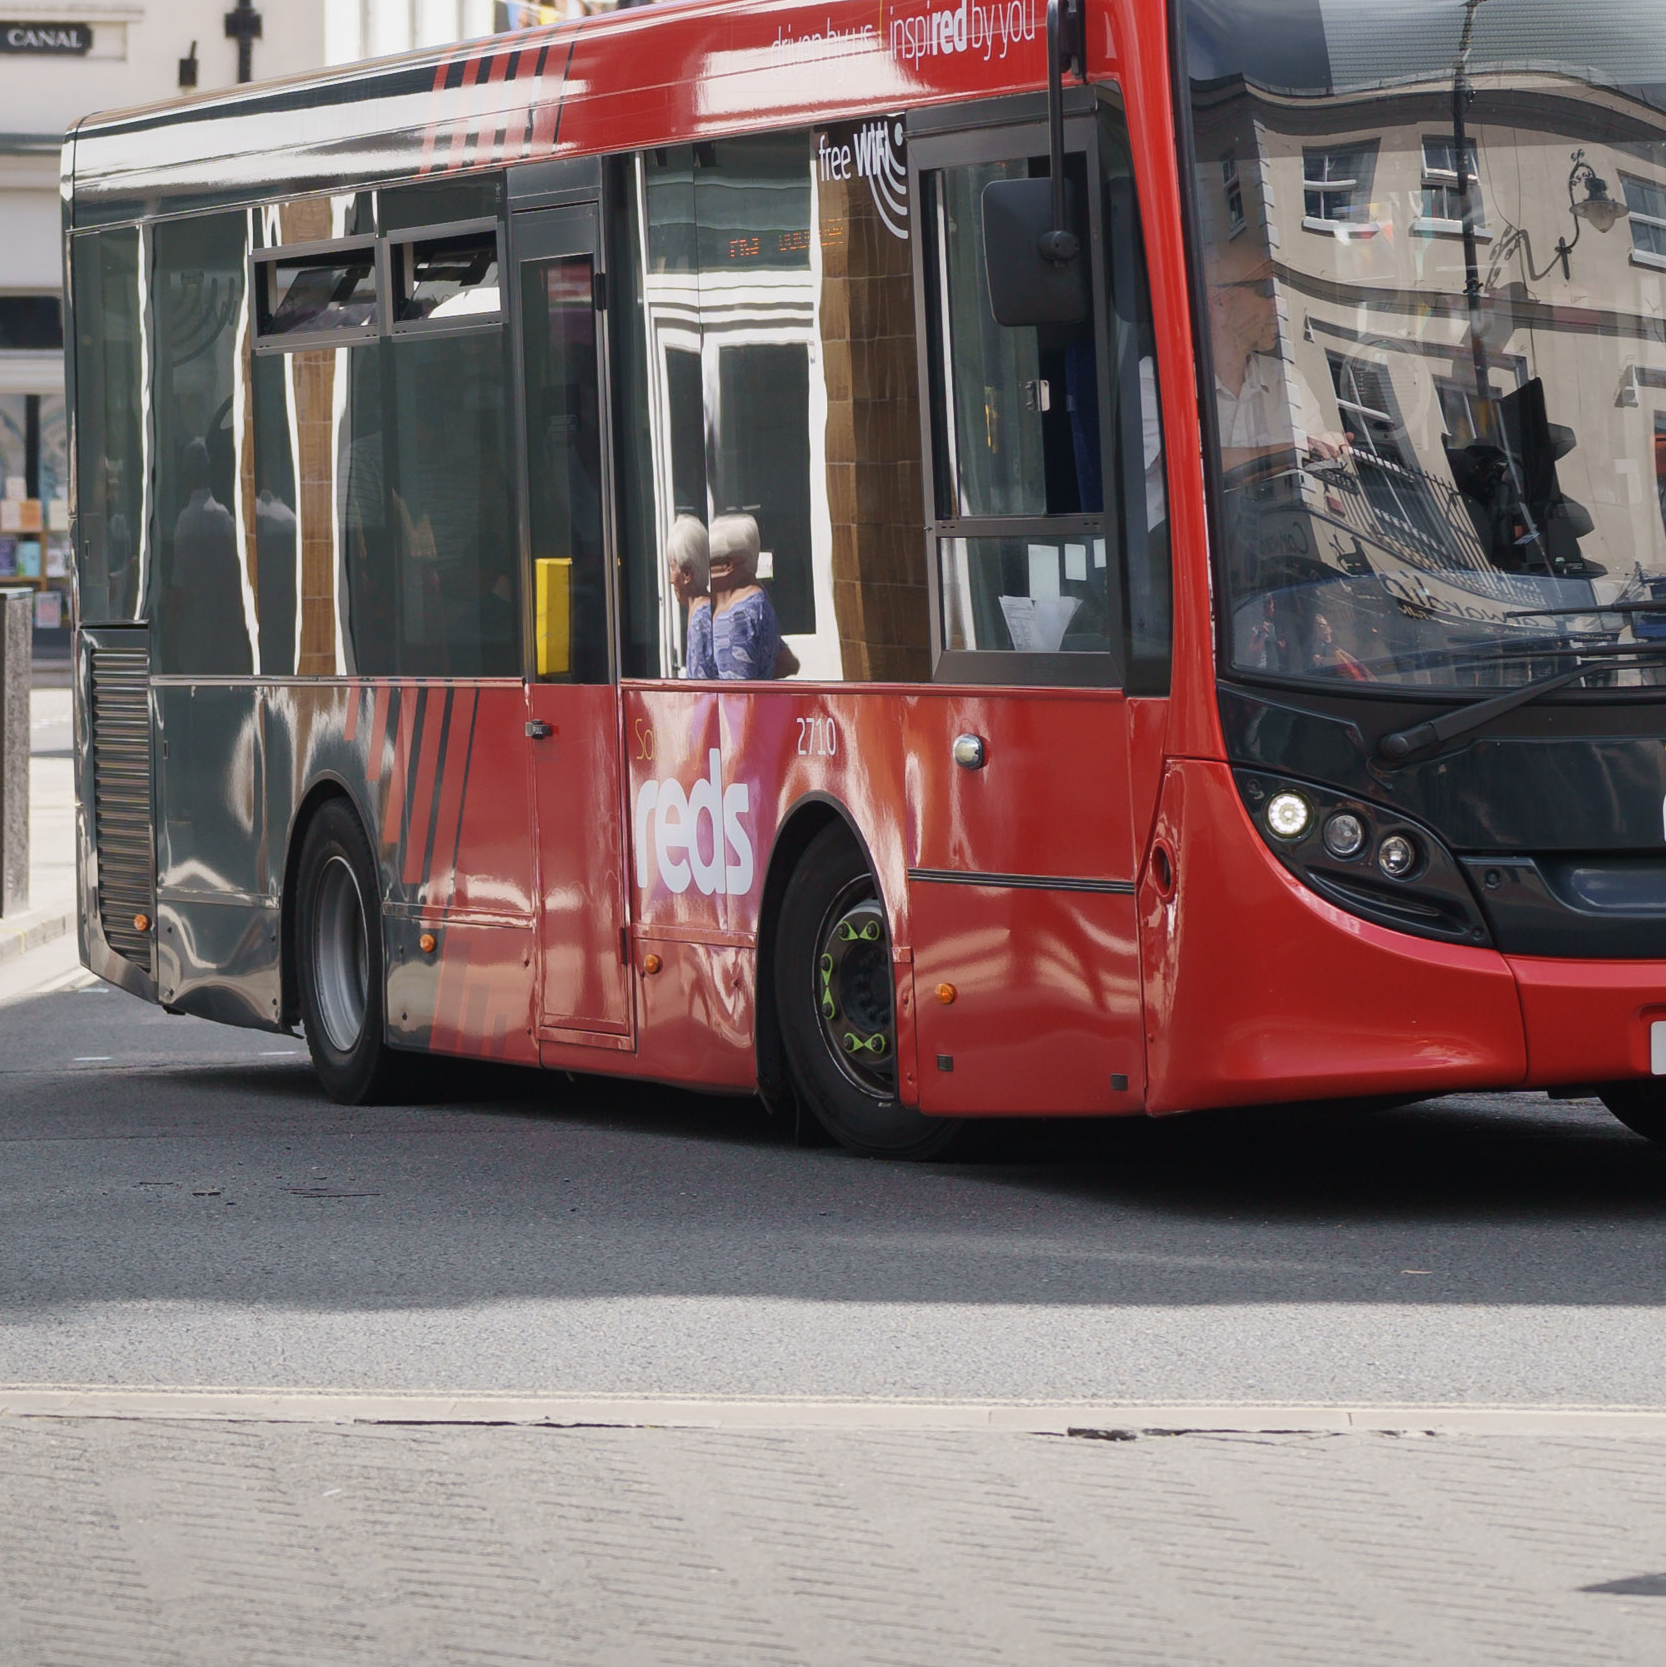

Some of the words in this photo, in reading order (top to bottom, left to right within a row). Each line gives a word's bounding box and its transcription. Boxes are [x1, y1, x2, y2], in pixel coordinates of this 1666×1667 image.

[7, 28, 82, 49] CANAL
[819, 134, 852, 182] free
[797, 718, 836, 756] 2710
[636, 748, 753, 896] reds
